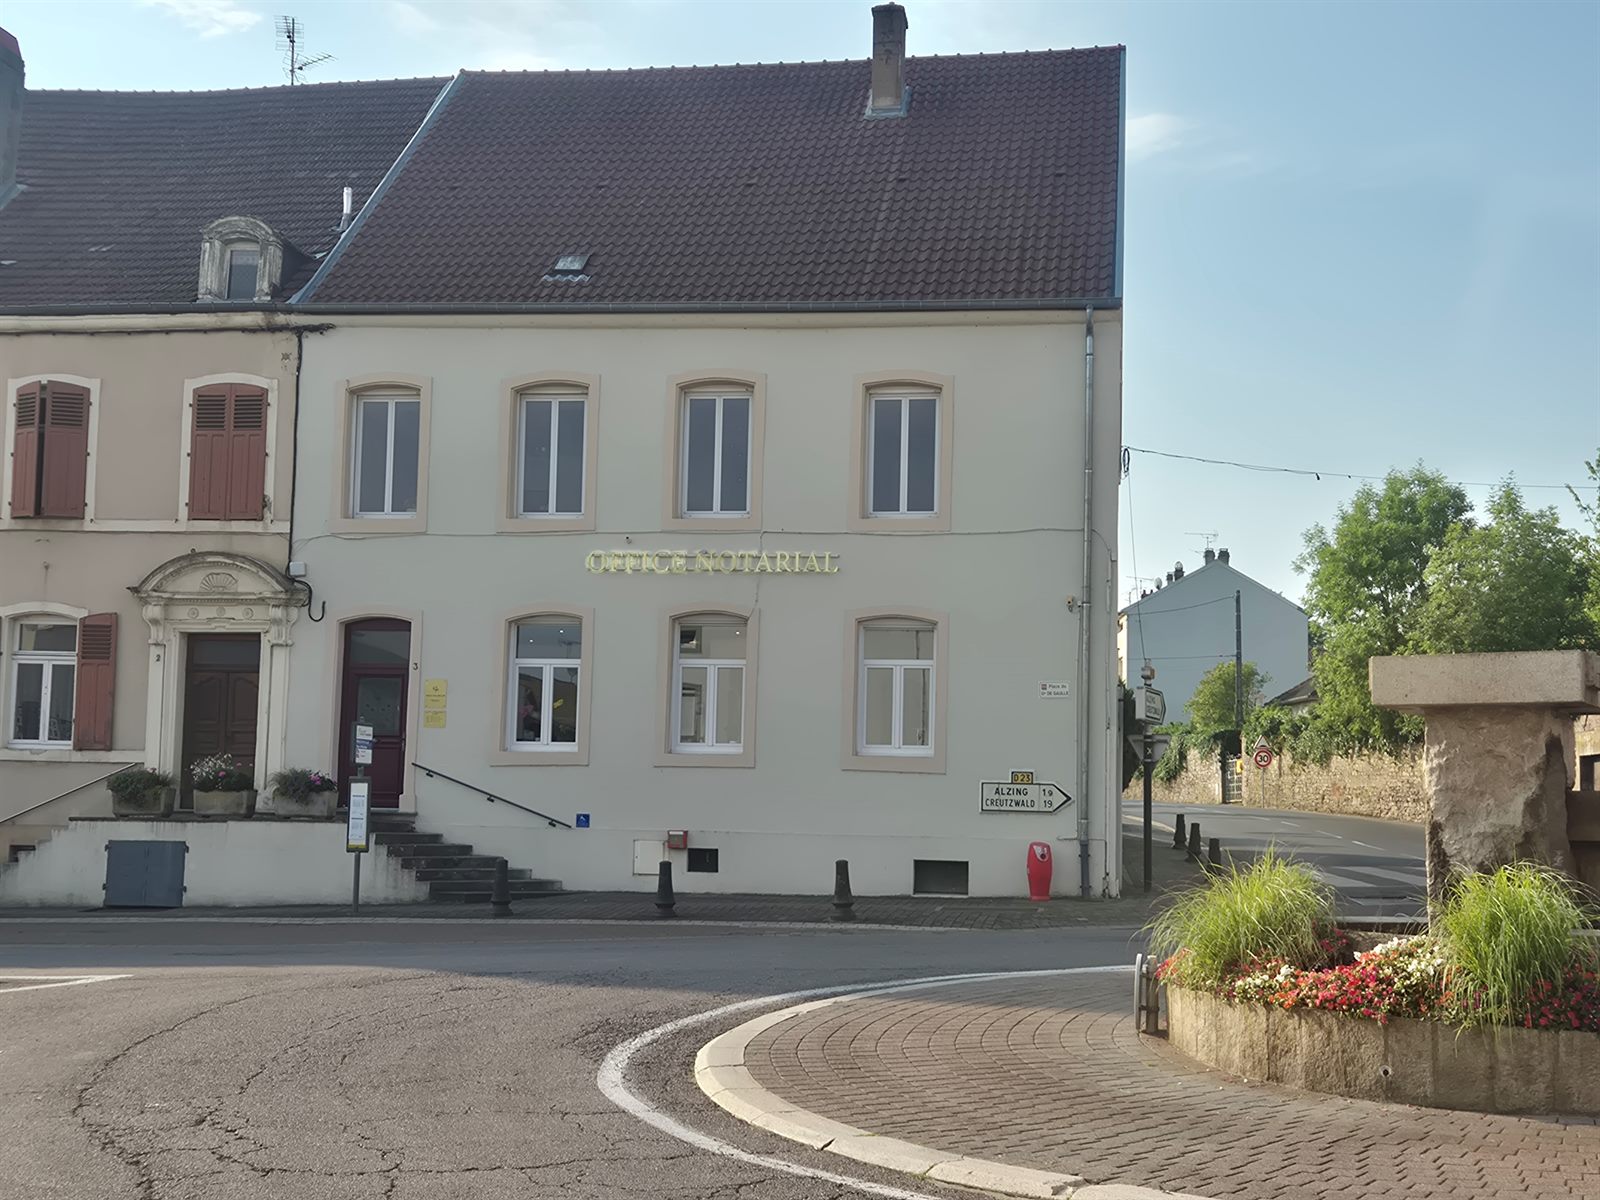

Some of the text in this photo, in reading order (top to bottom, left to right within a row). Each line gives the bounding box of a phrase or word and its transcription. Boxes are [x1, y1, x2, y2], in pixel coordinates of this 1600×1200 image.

[585, 550, 839, 574] OFFICE NOTARIAL
[412, 662, 419, 671] 3
[1258, 754, 1269, 763] 30
[994, 787, 1053, 797] ALZING 19
[985, 798, 1053, 808] CREUTZWALD 19
